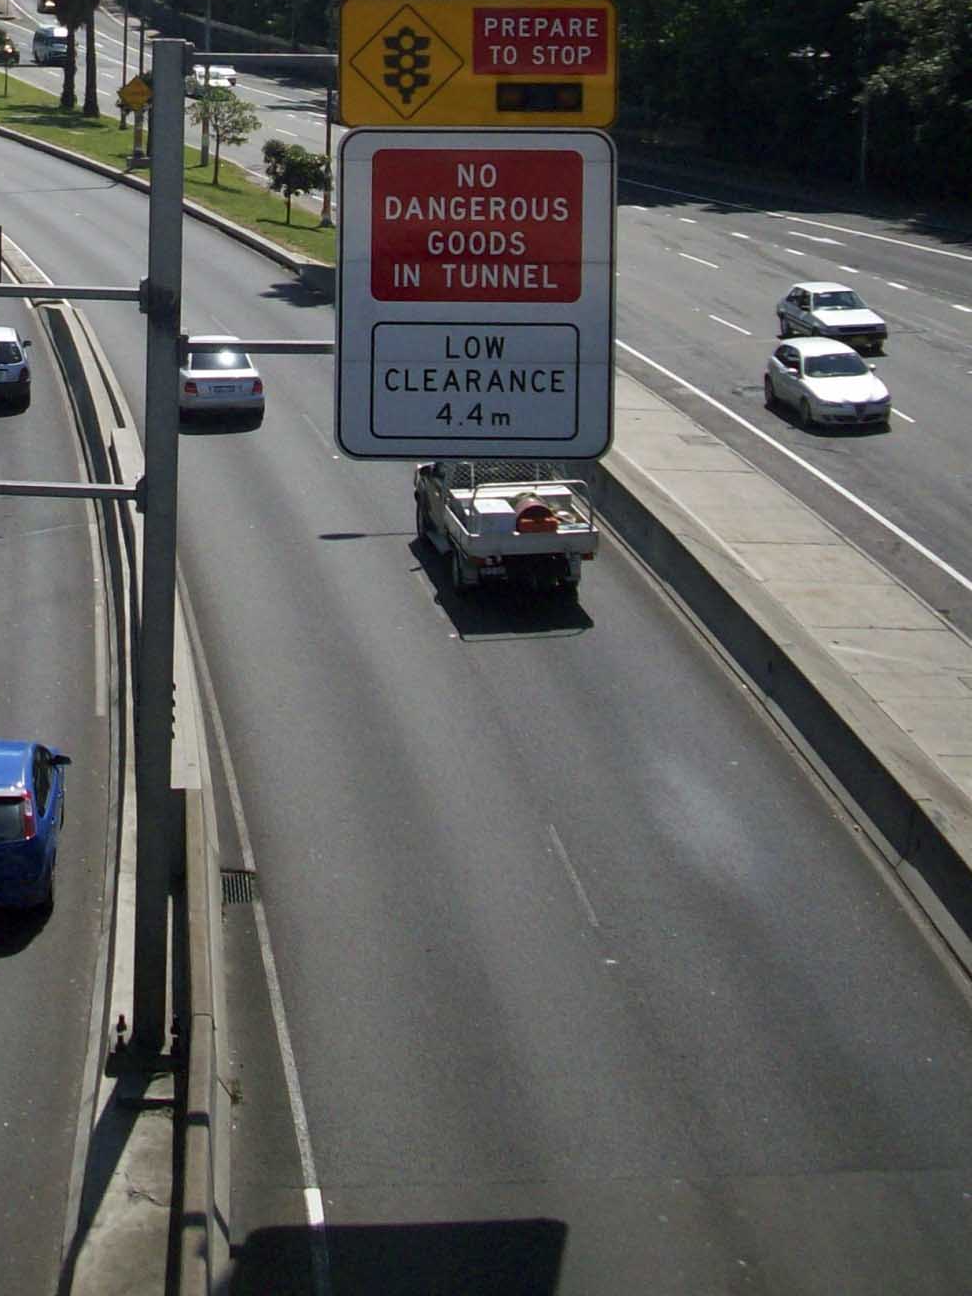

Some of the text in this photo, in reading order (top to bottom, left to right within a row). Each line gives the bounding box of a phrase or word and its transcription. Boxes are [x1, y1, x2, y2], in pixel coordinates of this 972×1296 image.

[484, 17, 599, 39] PREPARE
[489, 45, 592, 65] TO STOP
[456, 163, 498, 189] NO
[384, 196, 569, 222] DANGEROUS
[427, 230, 527, 256] GOODS
[393, 263, 558, 290] IN TUNNEL
[445, 335, 506, 360] LOW
[384, 368, 565, 393] CLEARANCE
